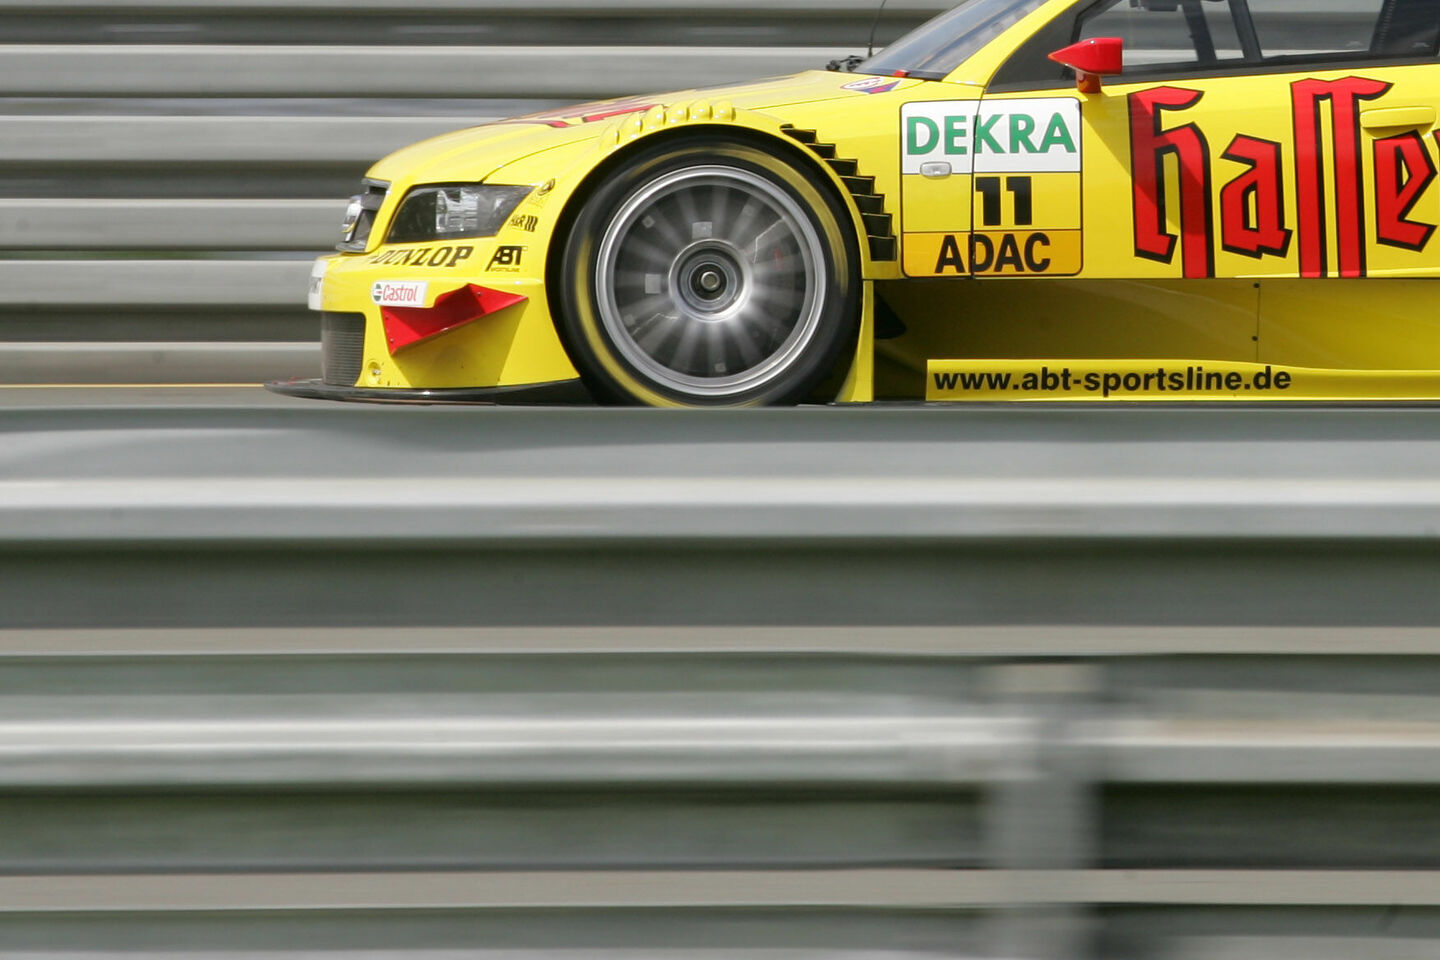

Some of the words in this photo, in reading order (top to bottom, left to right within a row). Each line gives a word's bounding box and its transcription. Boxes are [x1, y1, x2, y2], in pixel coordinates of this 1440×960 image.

[905, 112, 1078, 156] DEKRA
[975, 176, 1033, 227] 11
[368, 246, 474, 268] DUNLOP
[484, 246, 522, 272] ABT
[934, 232, 1051, 274] ADAC
[382, 284, 418, 302] Castrol
[933, 366, 1292, 398] www.abt-sportsline.de
